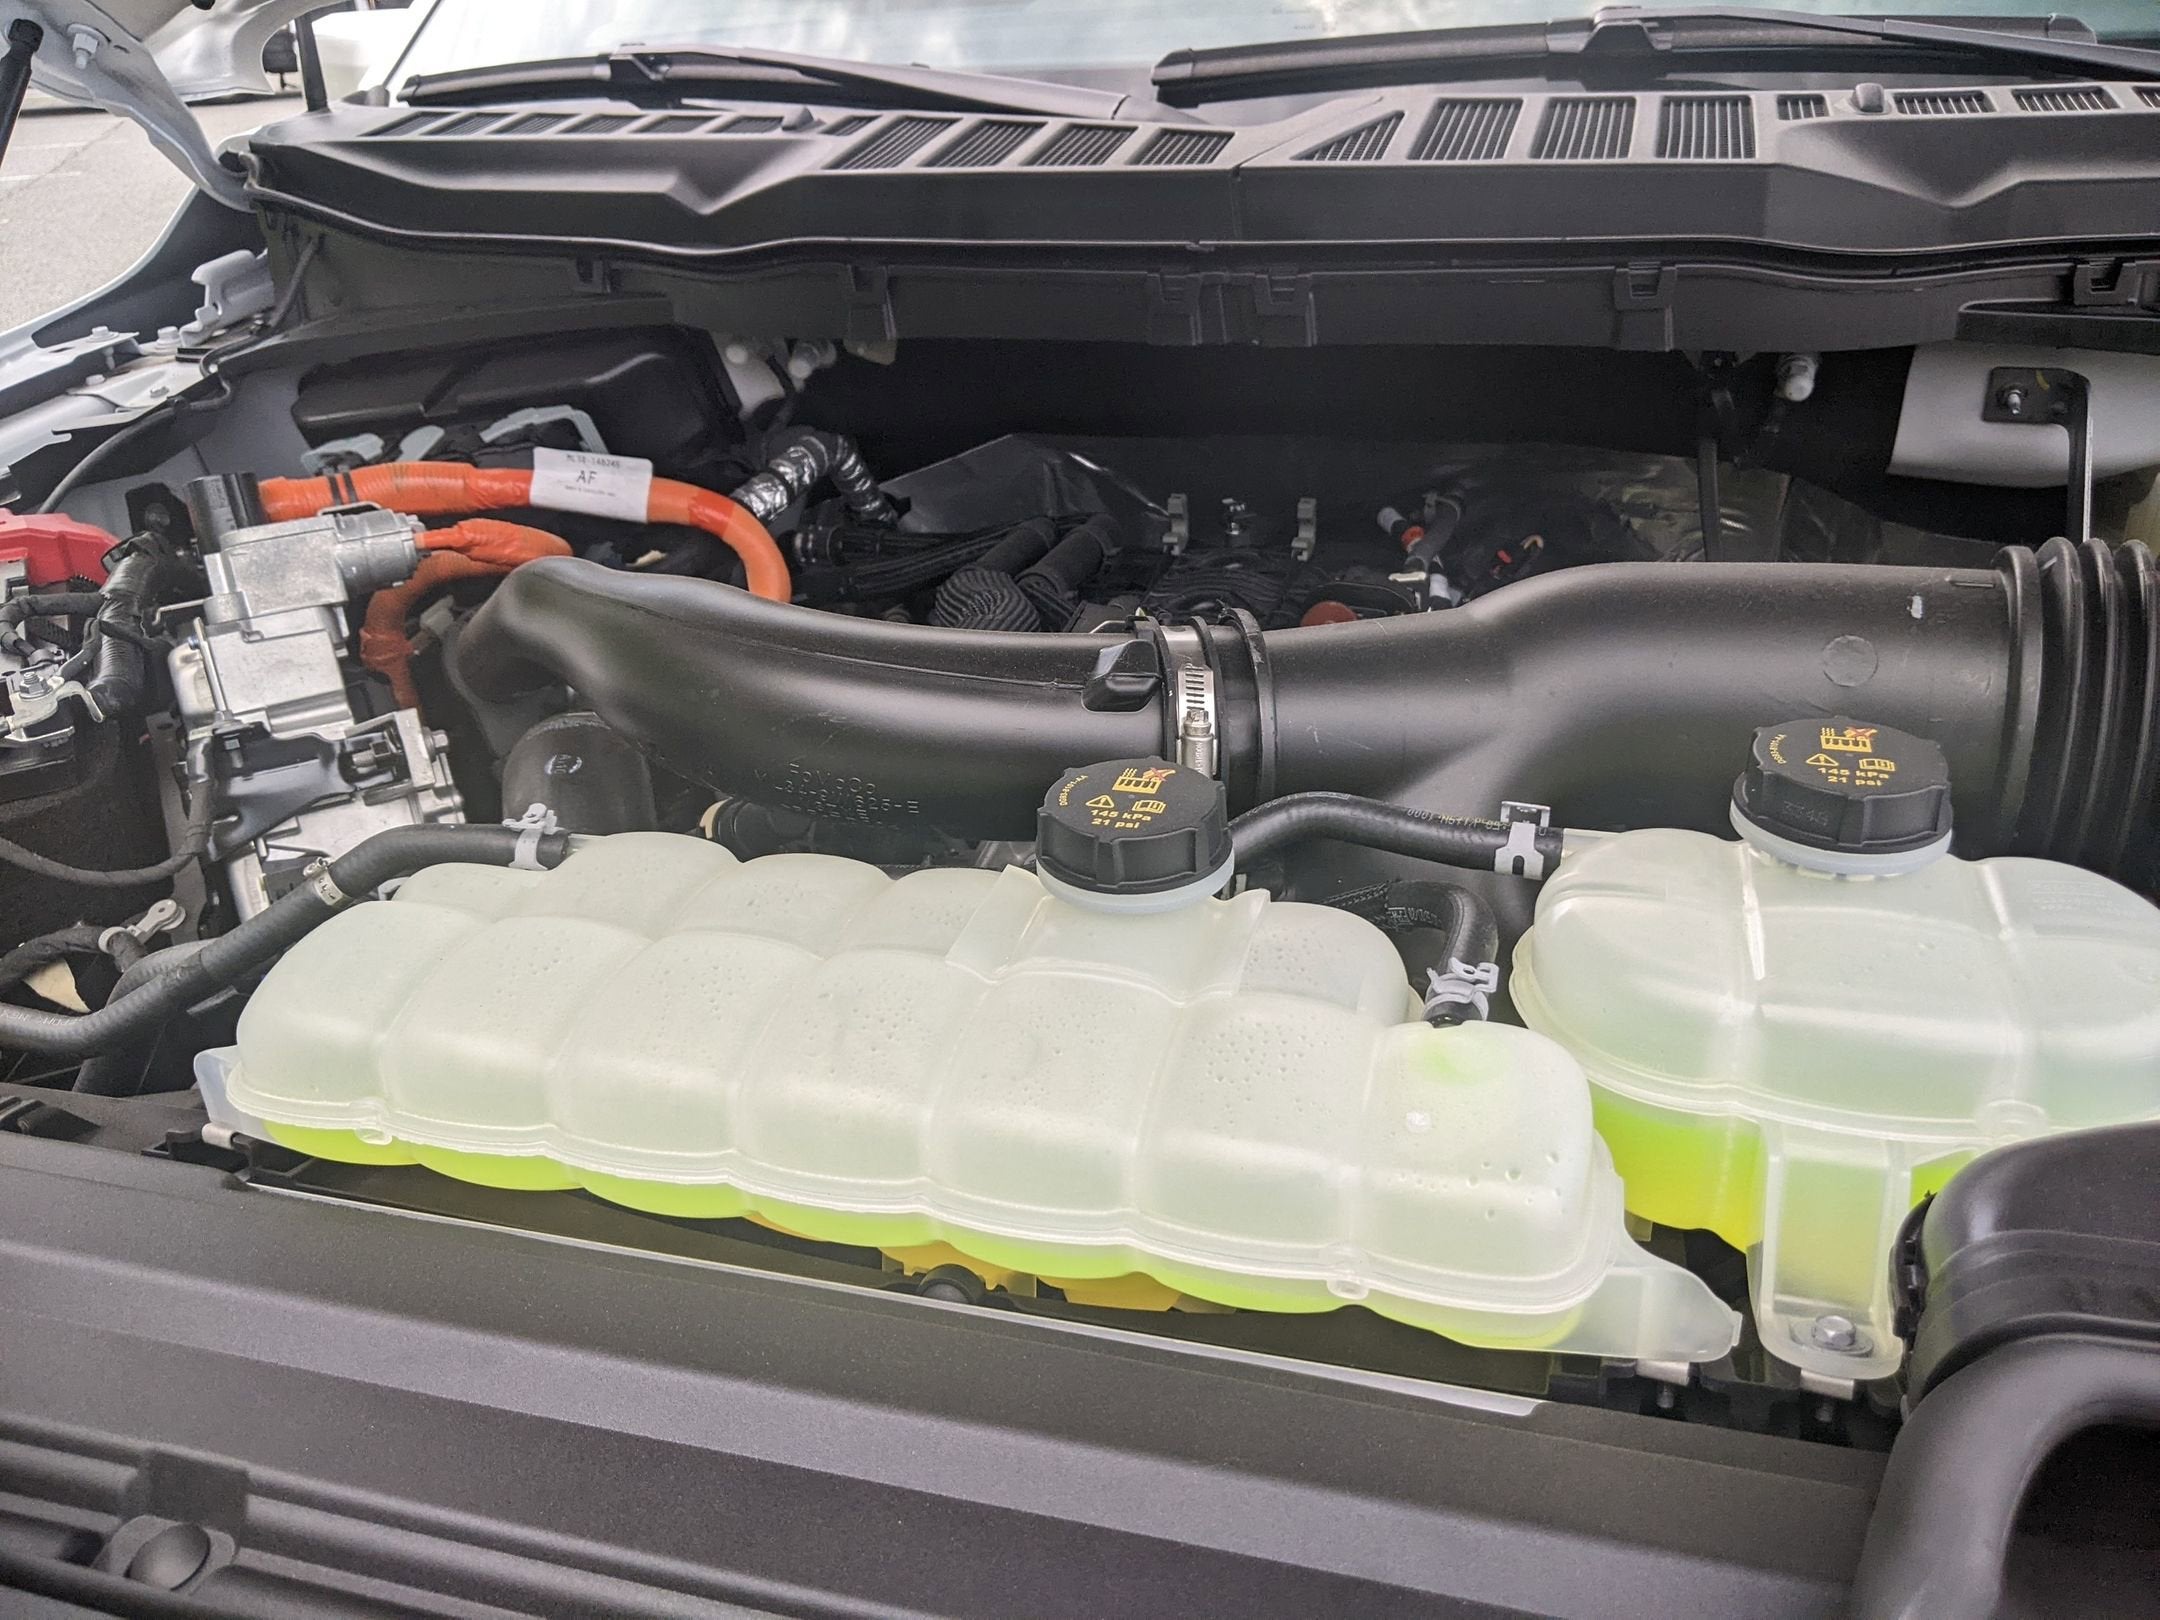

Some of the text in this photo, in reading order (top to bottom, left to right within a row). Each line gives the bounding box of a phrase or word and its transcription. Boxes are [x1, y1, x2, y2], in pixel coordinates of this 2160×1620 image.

[576, 470, 598, 485] AF
[1817, 767, 1890, 780] 145 kPa
[1827, 775, 1883, 787] 21 psi
[1090, 809, 1152, 822] 145 kPa
[1091, 818, 1140, 829] 21 psi
